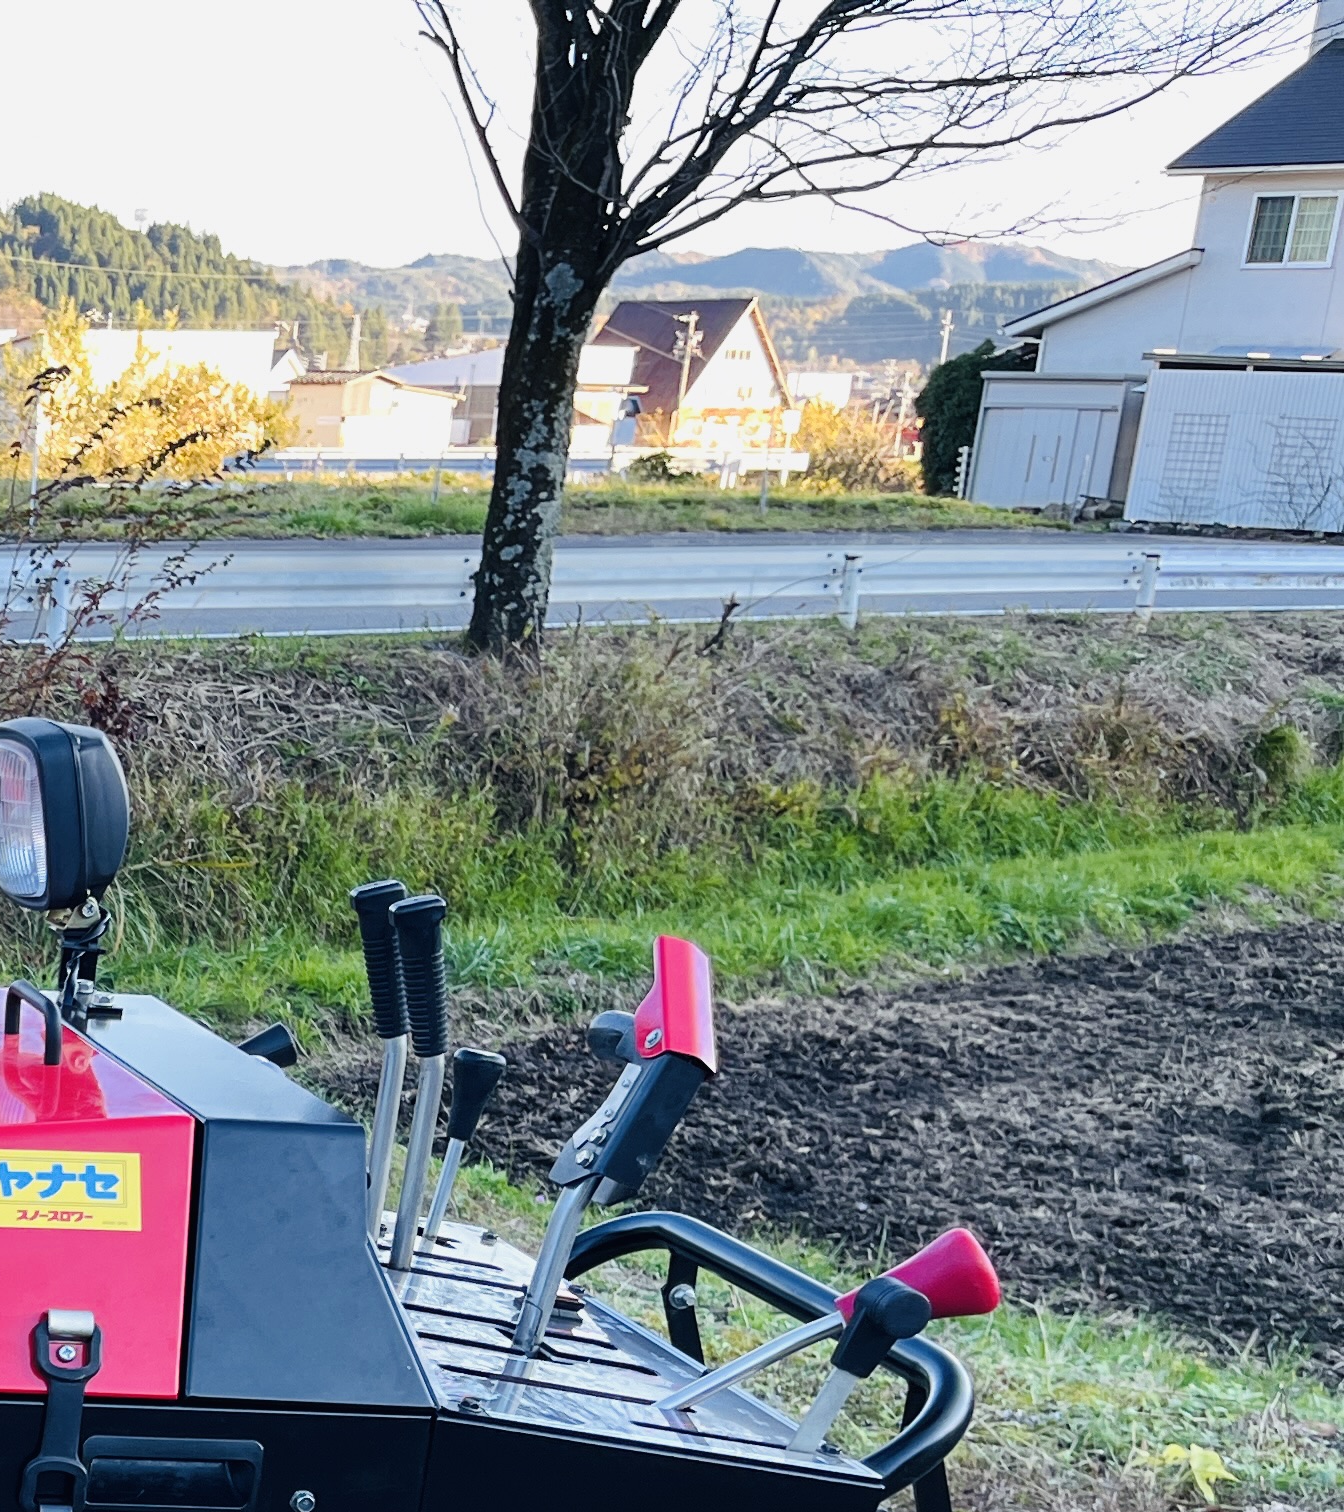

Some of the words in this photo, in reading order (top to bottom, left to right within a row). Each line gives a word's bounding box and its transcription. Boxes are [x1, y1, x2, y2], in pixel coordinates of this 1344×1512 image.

[16, 1209, 94, 1223] スノースロワー
